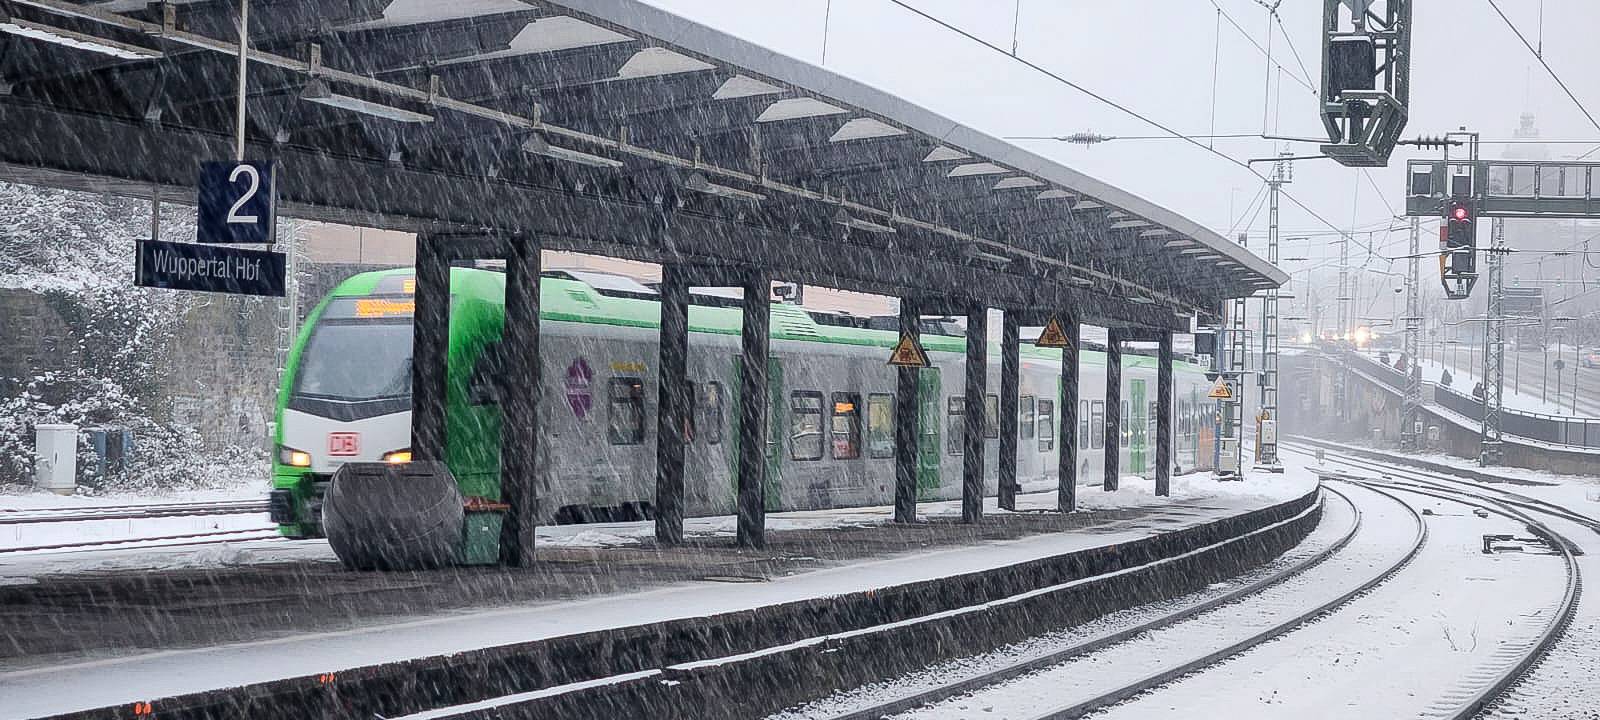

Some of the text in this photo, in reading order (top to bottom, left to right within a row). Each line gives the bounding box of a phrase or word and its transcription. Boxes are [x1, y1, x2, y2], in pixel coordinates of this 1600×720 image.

[227, 164, 260, 224] 2
[153, 249, 261, 281] Wuppertal Hbf
[330, 434, 358, 453] DB
